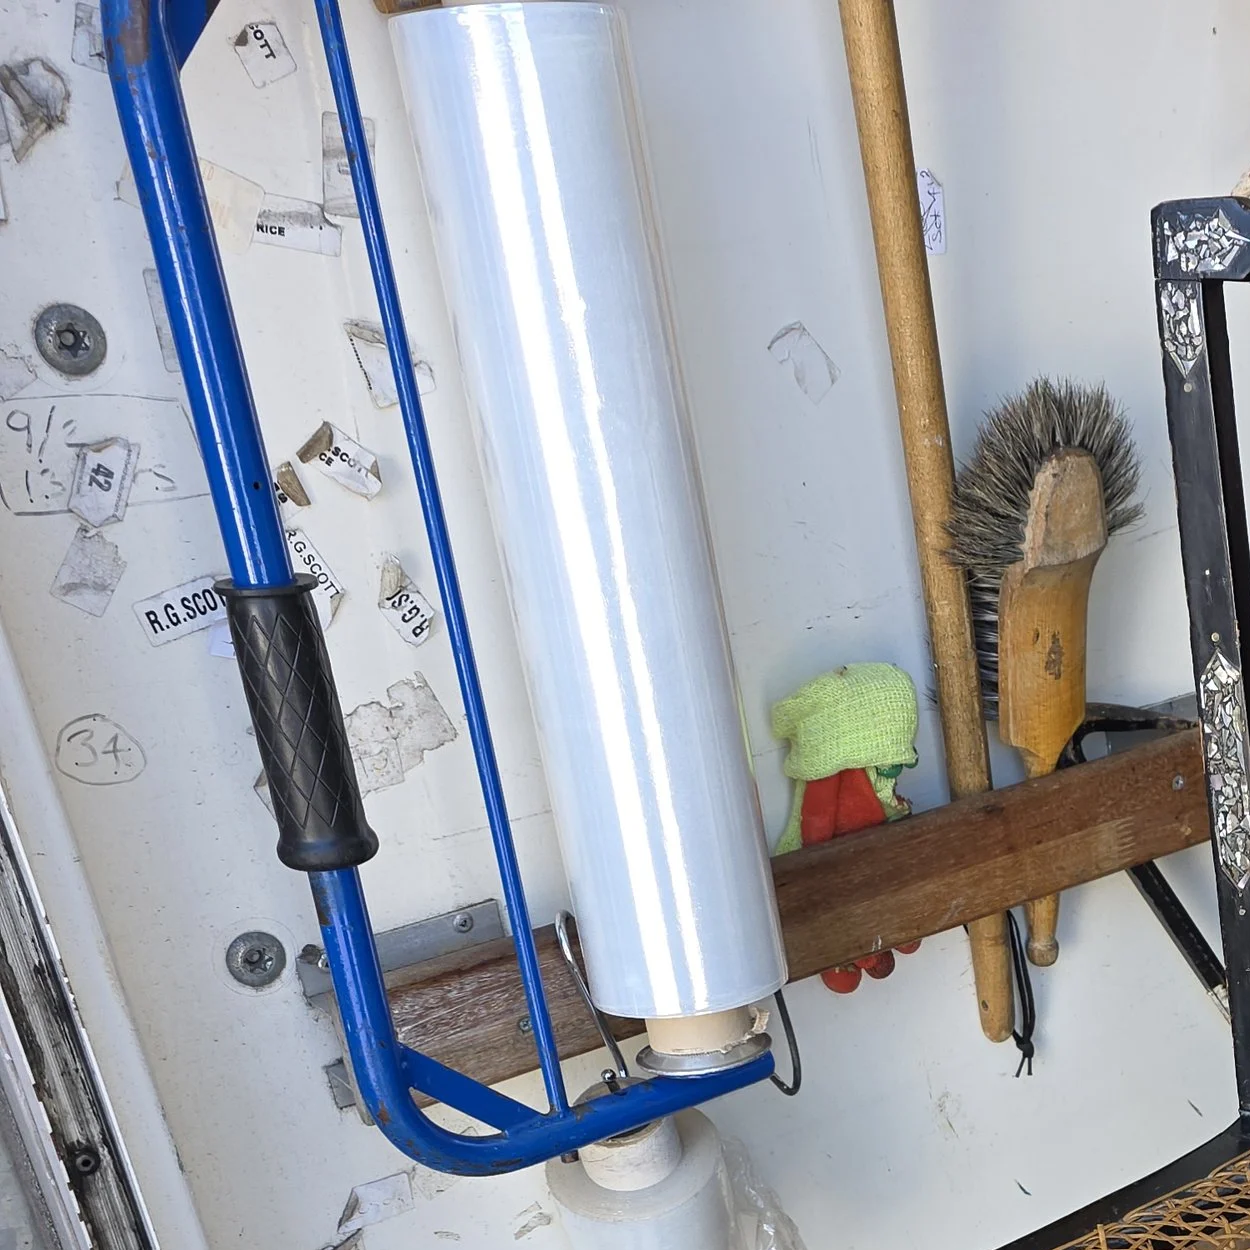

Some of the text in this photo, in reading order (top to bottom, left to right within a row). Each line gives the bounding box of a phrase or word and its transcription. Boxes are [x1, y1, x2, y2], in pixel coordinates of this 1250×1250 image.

[88, 463, 115, 492] 42
[386, 589, 429, 638] R.G.S
[67, 729, 131, 775] 34
